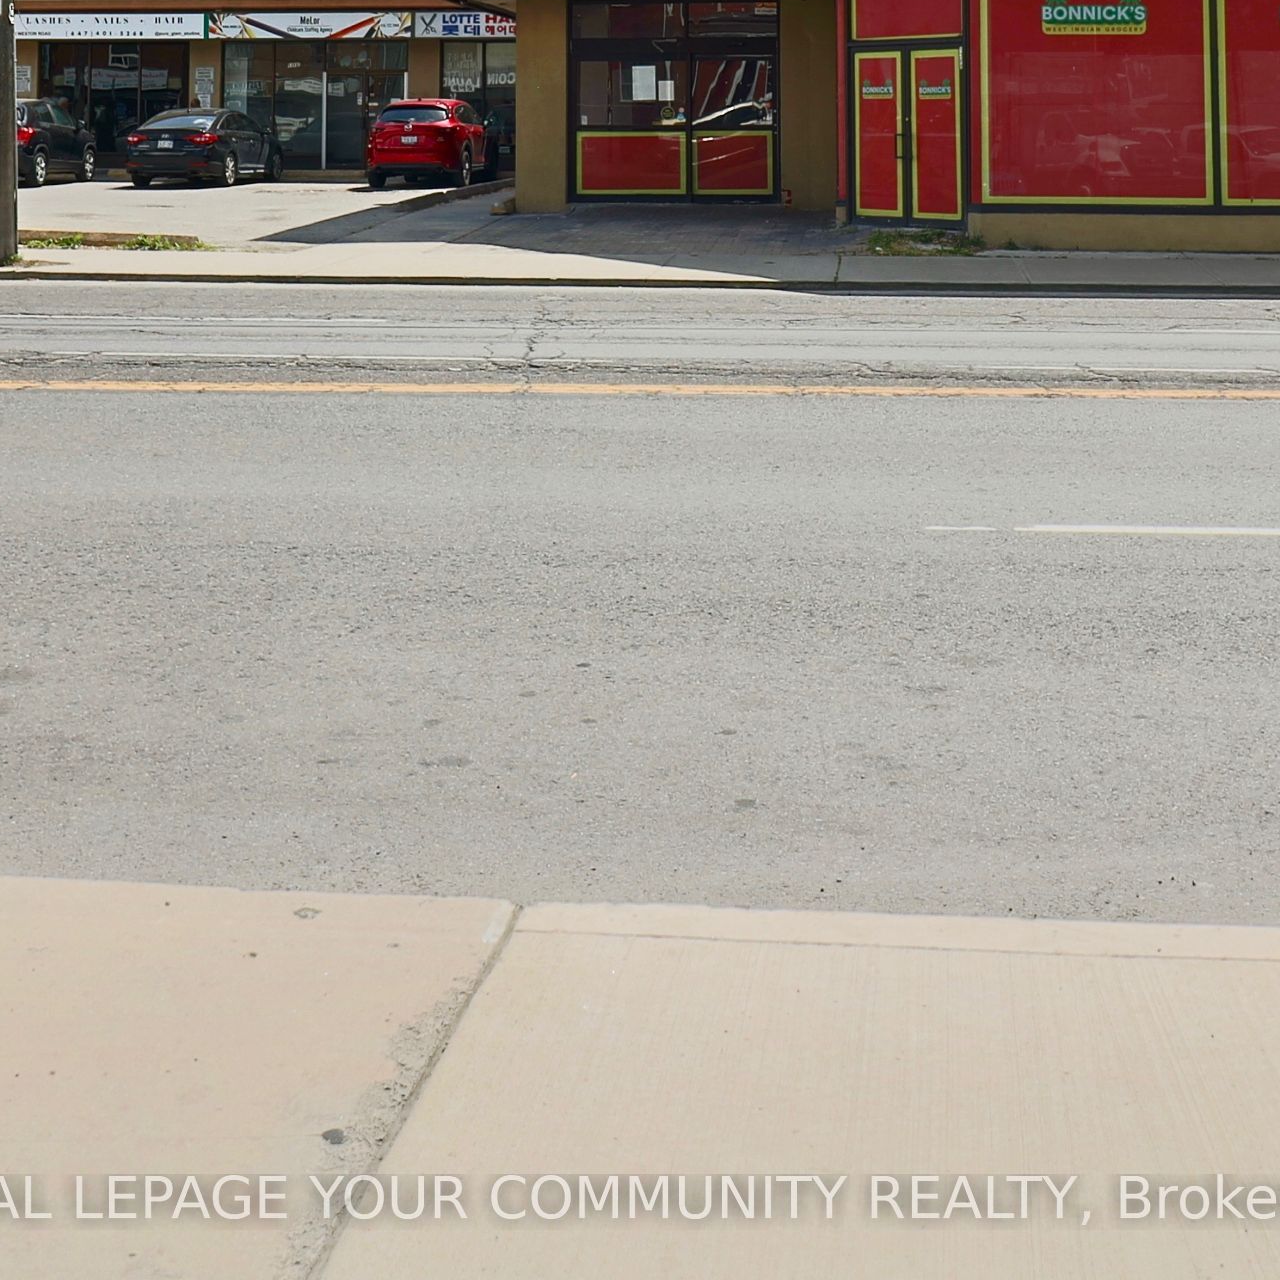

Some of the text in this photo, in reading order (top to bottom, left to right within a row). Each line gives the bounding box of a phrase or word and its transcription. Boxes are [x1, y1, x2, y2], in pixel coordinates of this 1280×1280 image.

[1042, 6, 1146, 21] BONNICK'S
[26, 16, 184, 25] LASHES NAILS HAIR
[442, 14, 480, 24] LOTTE
